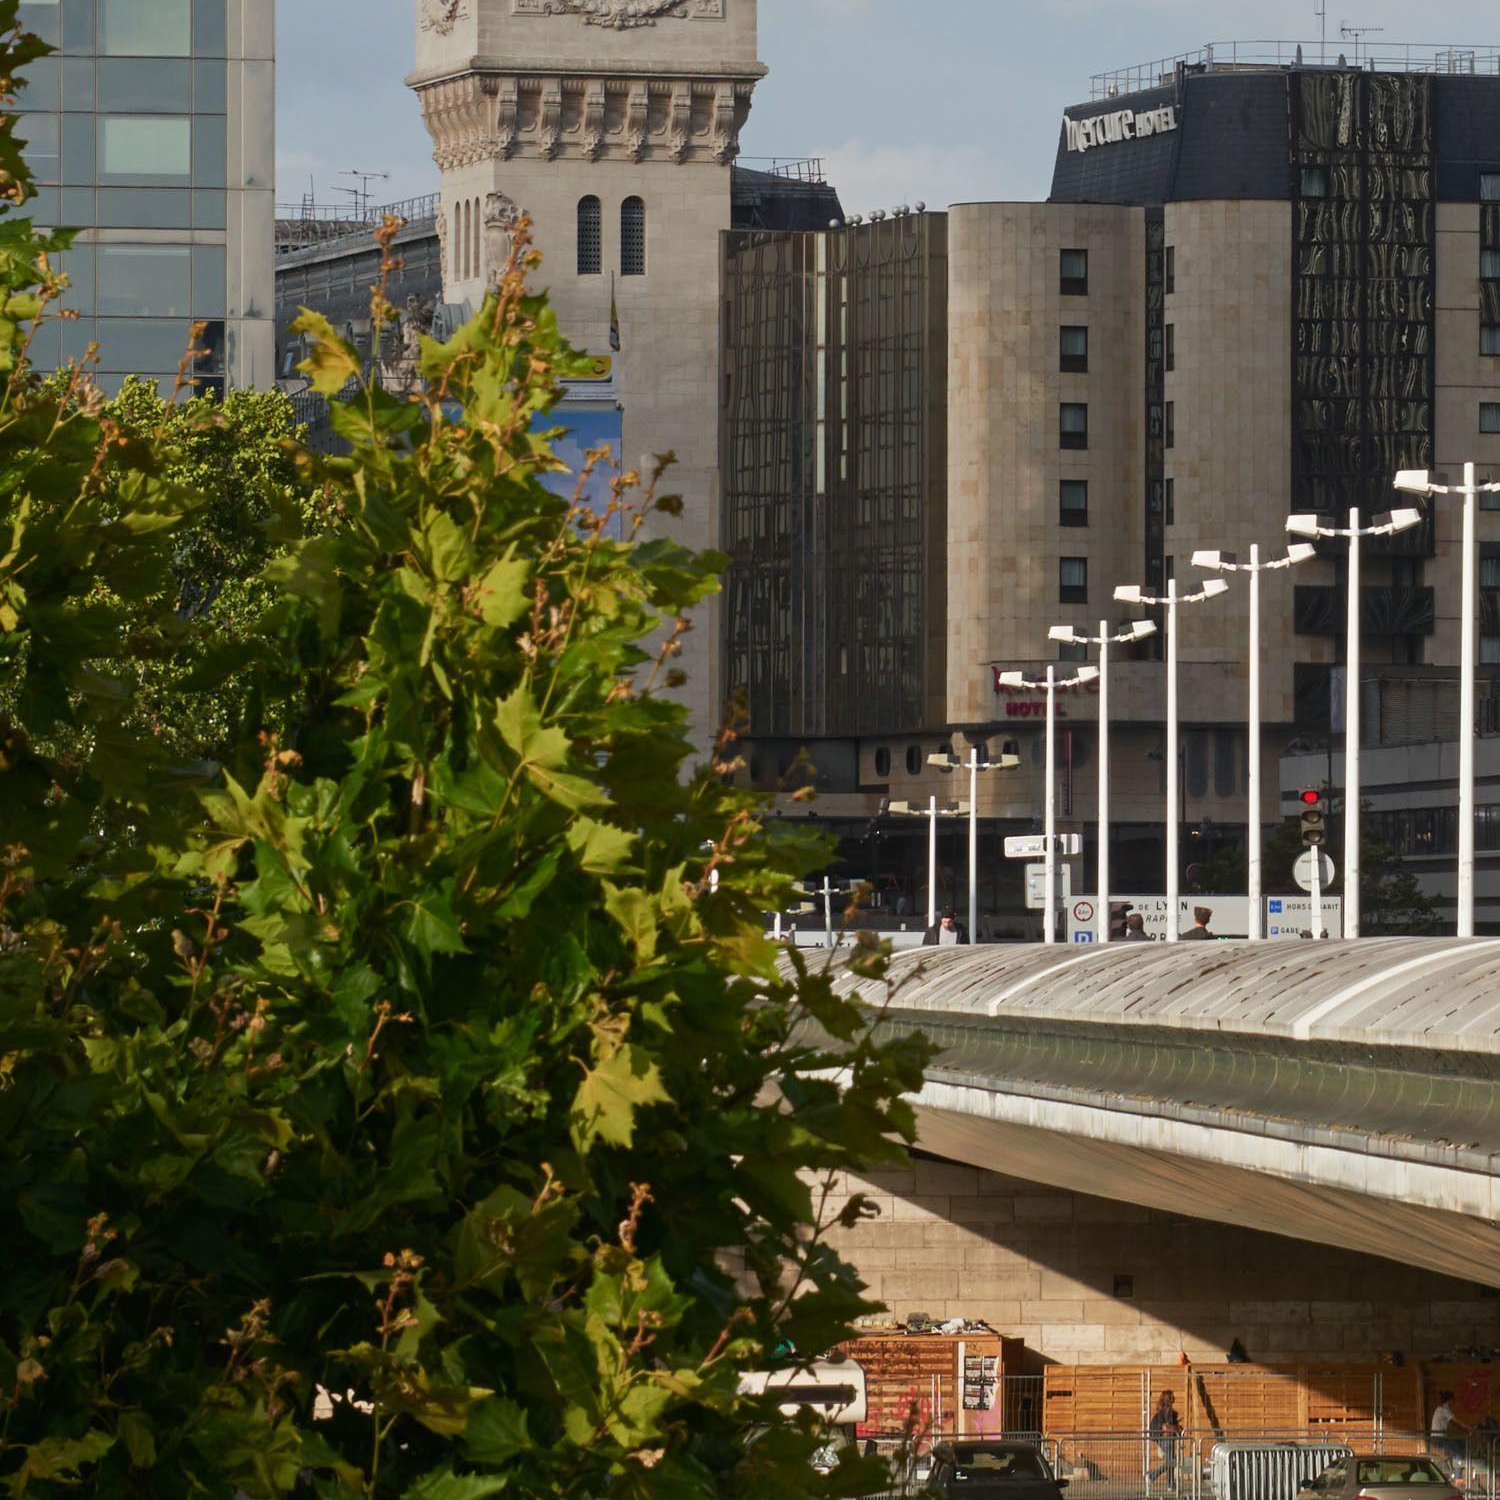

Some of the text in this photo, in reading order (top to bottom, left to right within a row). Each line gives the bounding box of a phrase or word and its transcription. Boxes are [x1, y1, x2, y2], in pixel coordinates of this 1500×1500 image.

[1136, 109, 1178, 137] HOTEL
[1006, 702, 1067, 717] HOTL
[1156, 900, 1188, 911] LYN
[1145, 914, 1182, 923] RAPIE
